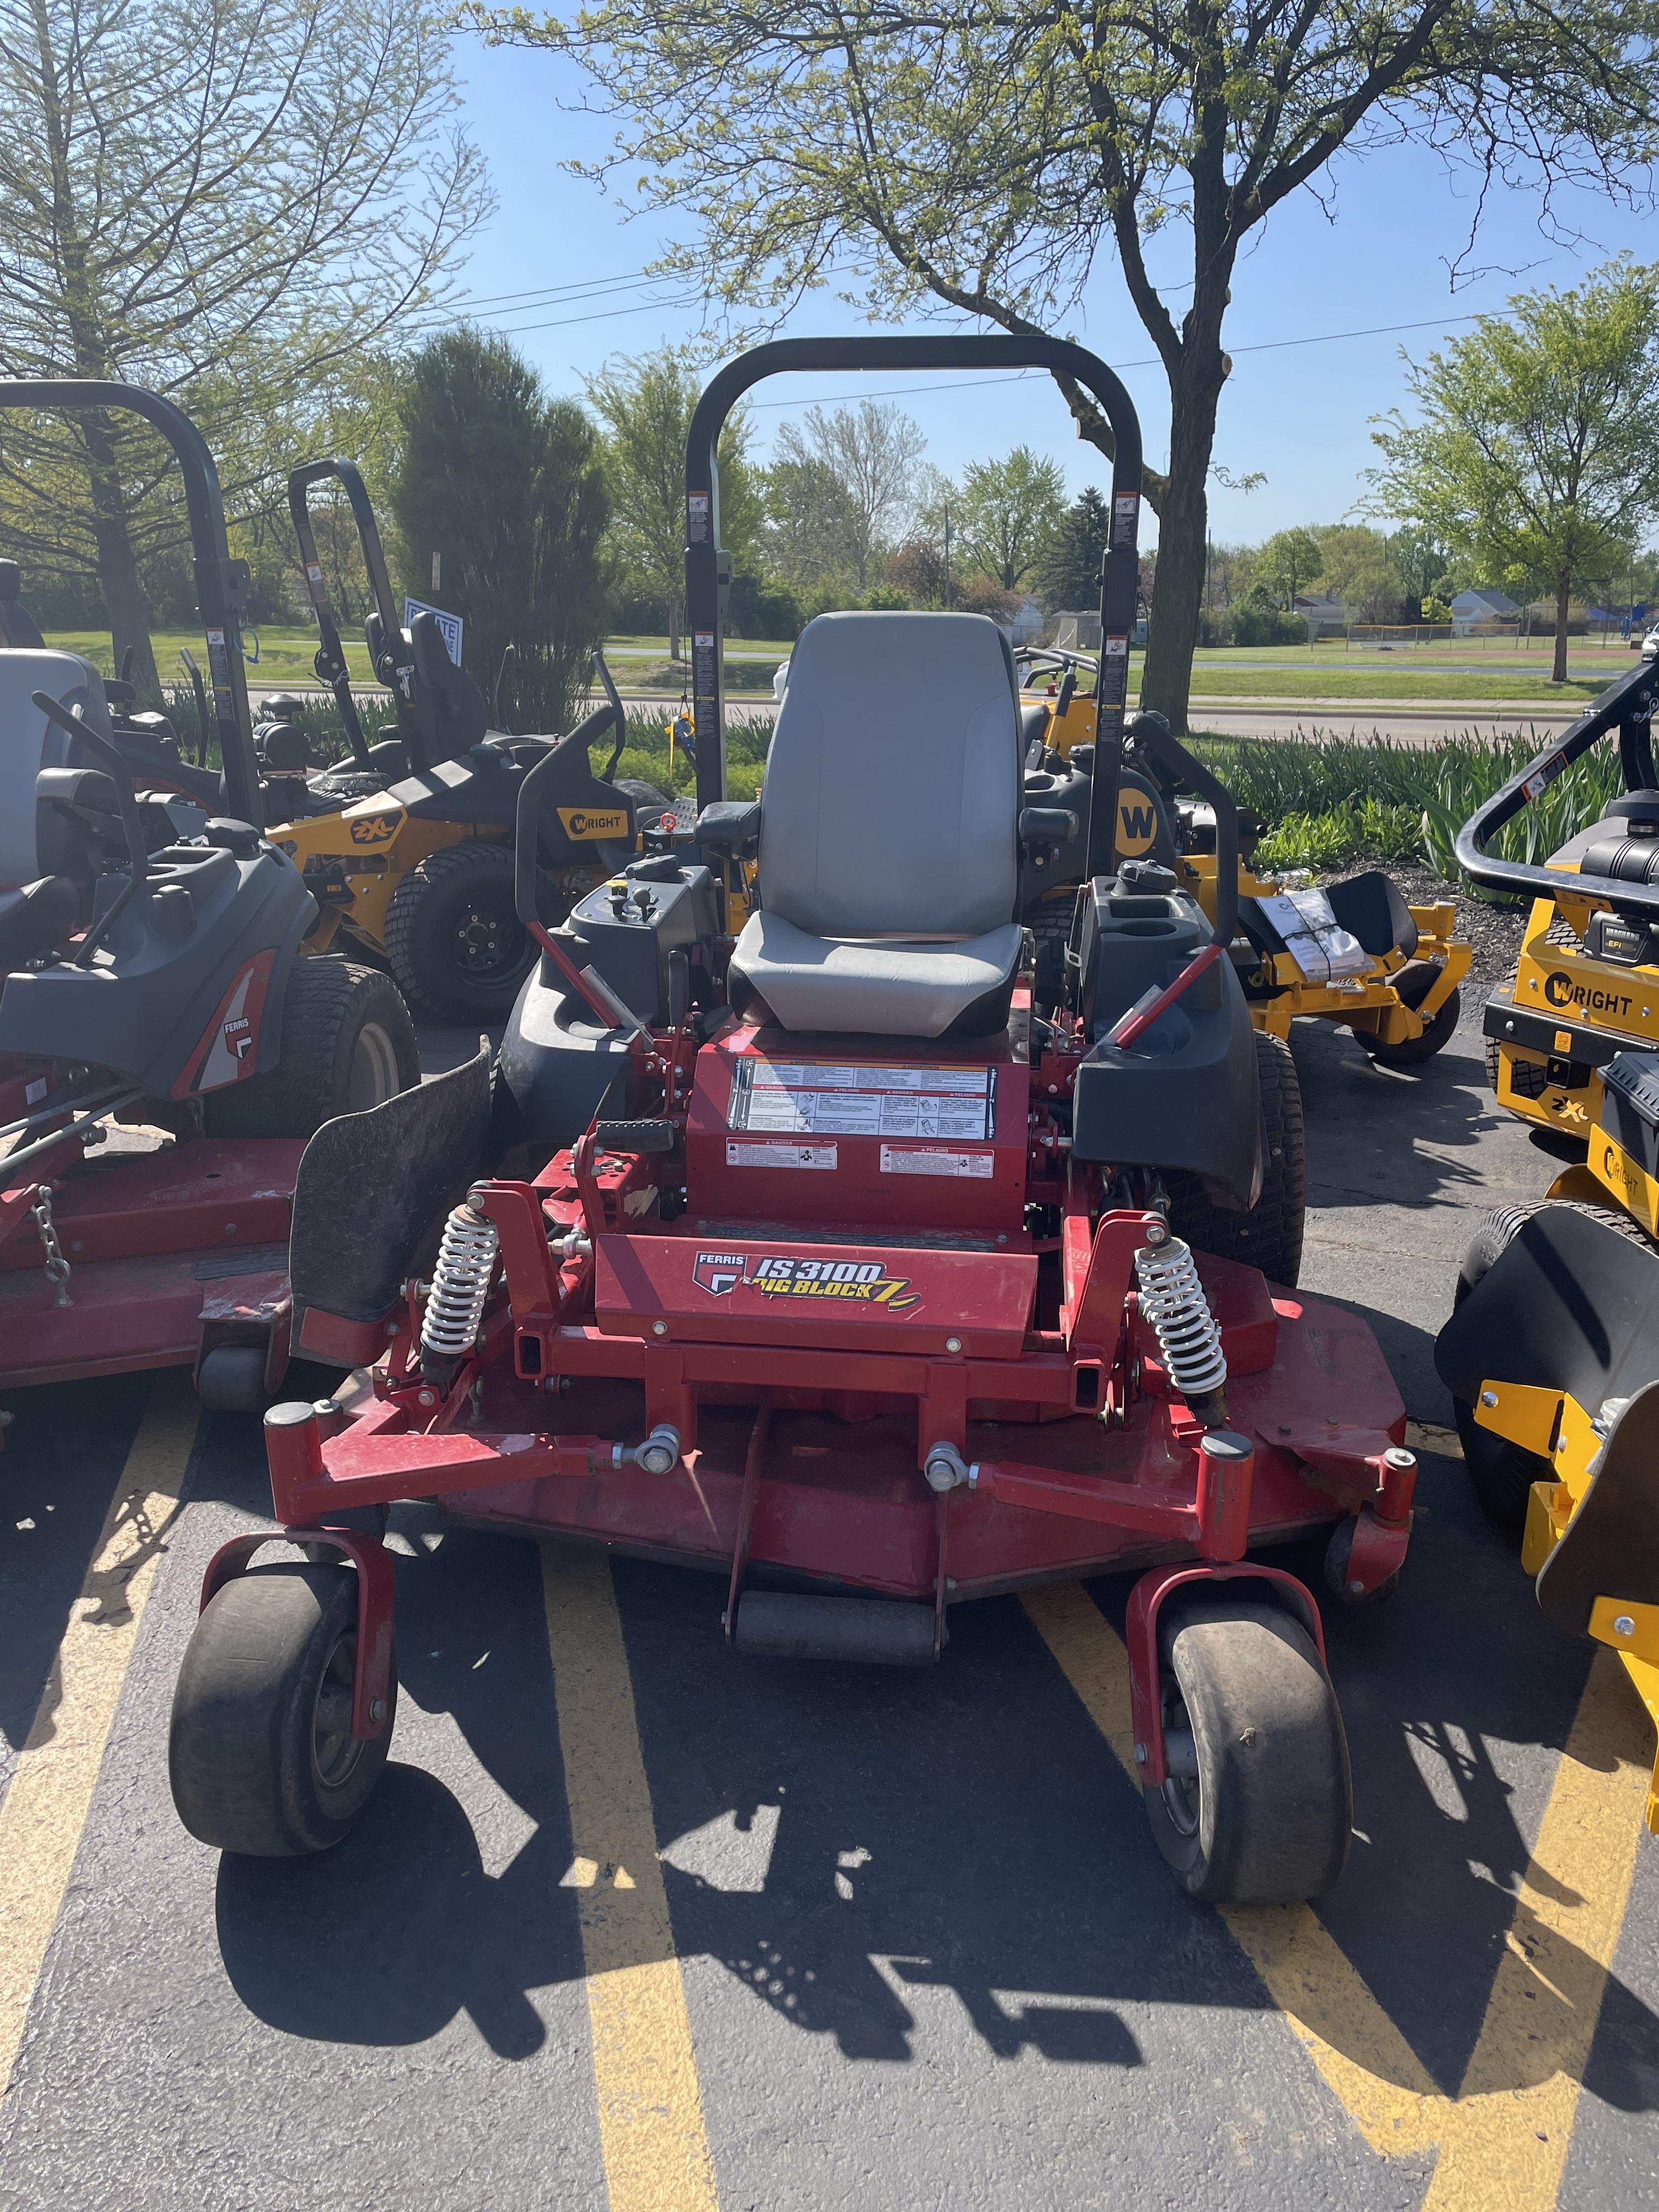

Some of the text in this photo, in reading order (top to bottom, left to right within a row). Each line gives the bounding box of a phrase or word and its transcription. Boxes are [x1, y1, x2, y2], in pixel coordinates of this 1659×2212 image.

[570, 814, 621, 834] WRIGHT
[1120, 806, 1154, 839] W
[1608, 940, 1622, 949] EFI
[1546, 972, 1633, 1015] WRIGHT
[224, 1018, 250, 1034] FERRIS
[699, 1254, 744, 1265] FERRIS
[757, 1259, 882, 1283] IS 3100
[792, 1280, 874, 1299] BLOCK
